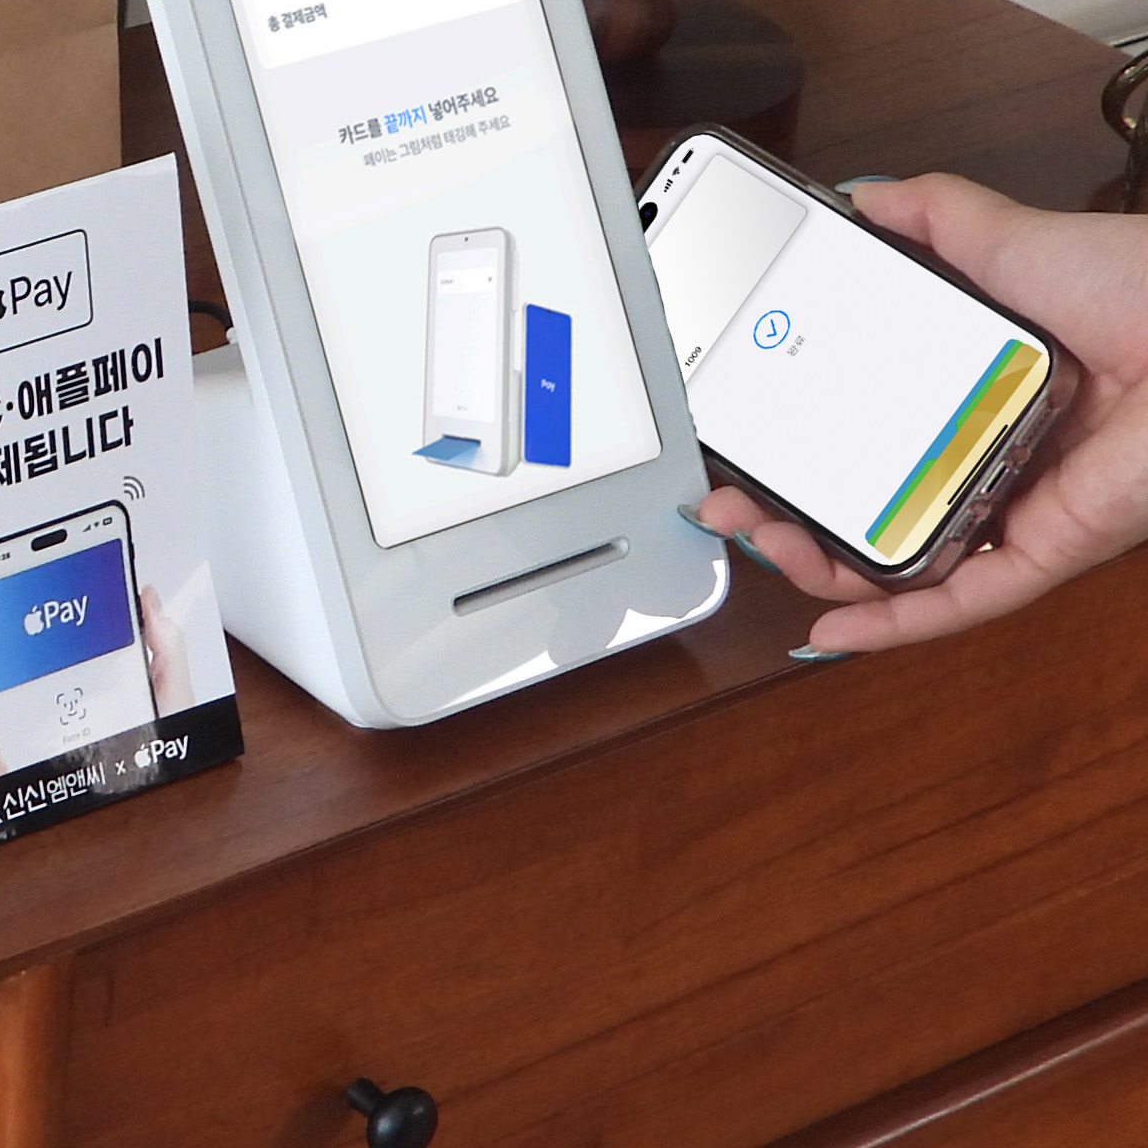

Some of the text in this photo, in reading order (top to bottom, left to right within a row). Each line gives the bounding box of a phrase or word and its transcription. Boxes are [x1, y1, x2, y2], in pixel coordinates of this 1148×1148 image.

[268, 3, 328, 33] 총 결제금액
[338, 86, 500, 145] 카드를 끝까지 넣어주세요
[363, 114, 511, 167] 페이는 그림처럼 태깅해 주세요
[10, 270, 73, 315] Pay
[684, 346, 703, 367] 1009
[540, 379, 556, 393] Pay
[43, 595, 89, 630] Pay
[3, 762, 106, 821] 신신엠앤씨
[150, 735, 190, 764] Pay
